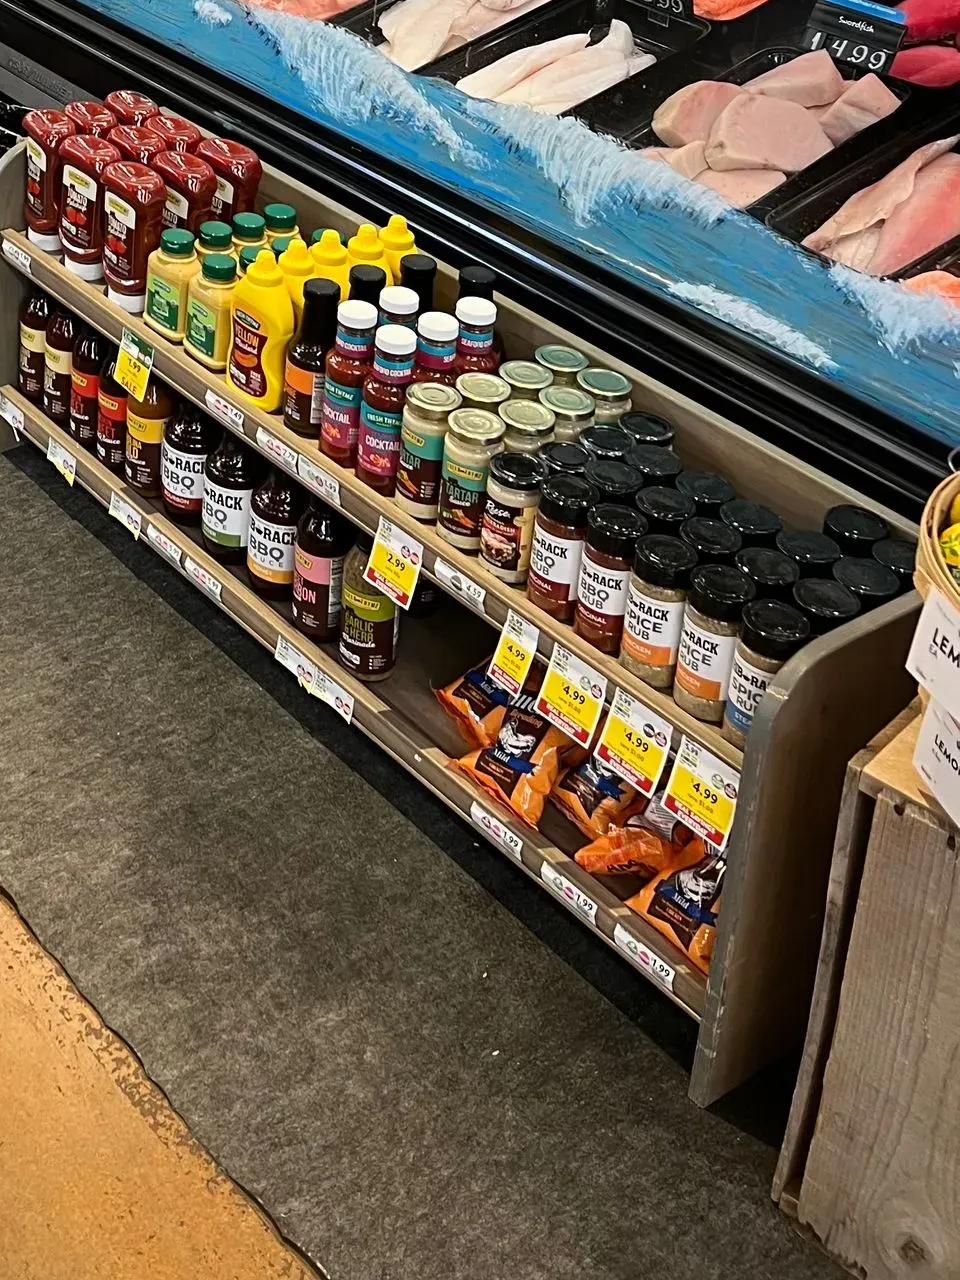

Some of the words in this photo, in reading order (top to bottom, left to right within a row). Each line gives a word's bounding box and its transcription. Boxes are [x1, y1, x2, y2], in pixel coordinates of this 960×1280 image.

[838, 16, 874, 33] Swordfish
[234, 322, 259, 347] YELLOW
[121, 377, 137, 395] SALE
[365, 435, 401, 451] COCKTAIL
[164, 466, 194, 490] BBQ
[446, 481, 479, 504] TARTAR
[448, 496, 471, 507] Sauce
[250, 535, 284, 561] BBQ
[466, 583, 482, 598] 4.59
[581, 582, 610, 602] BBQ
[581, 592, 604, 610] RUB
[350, 626, 374, 643] HERB
[628, 624, 650, 641] RUB
[494, 749, 511, 763] Mild
[673, 892, 690, 909] Mild
